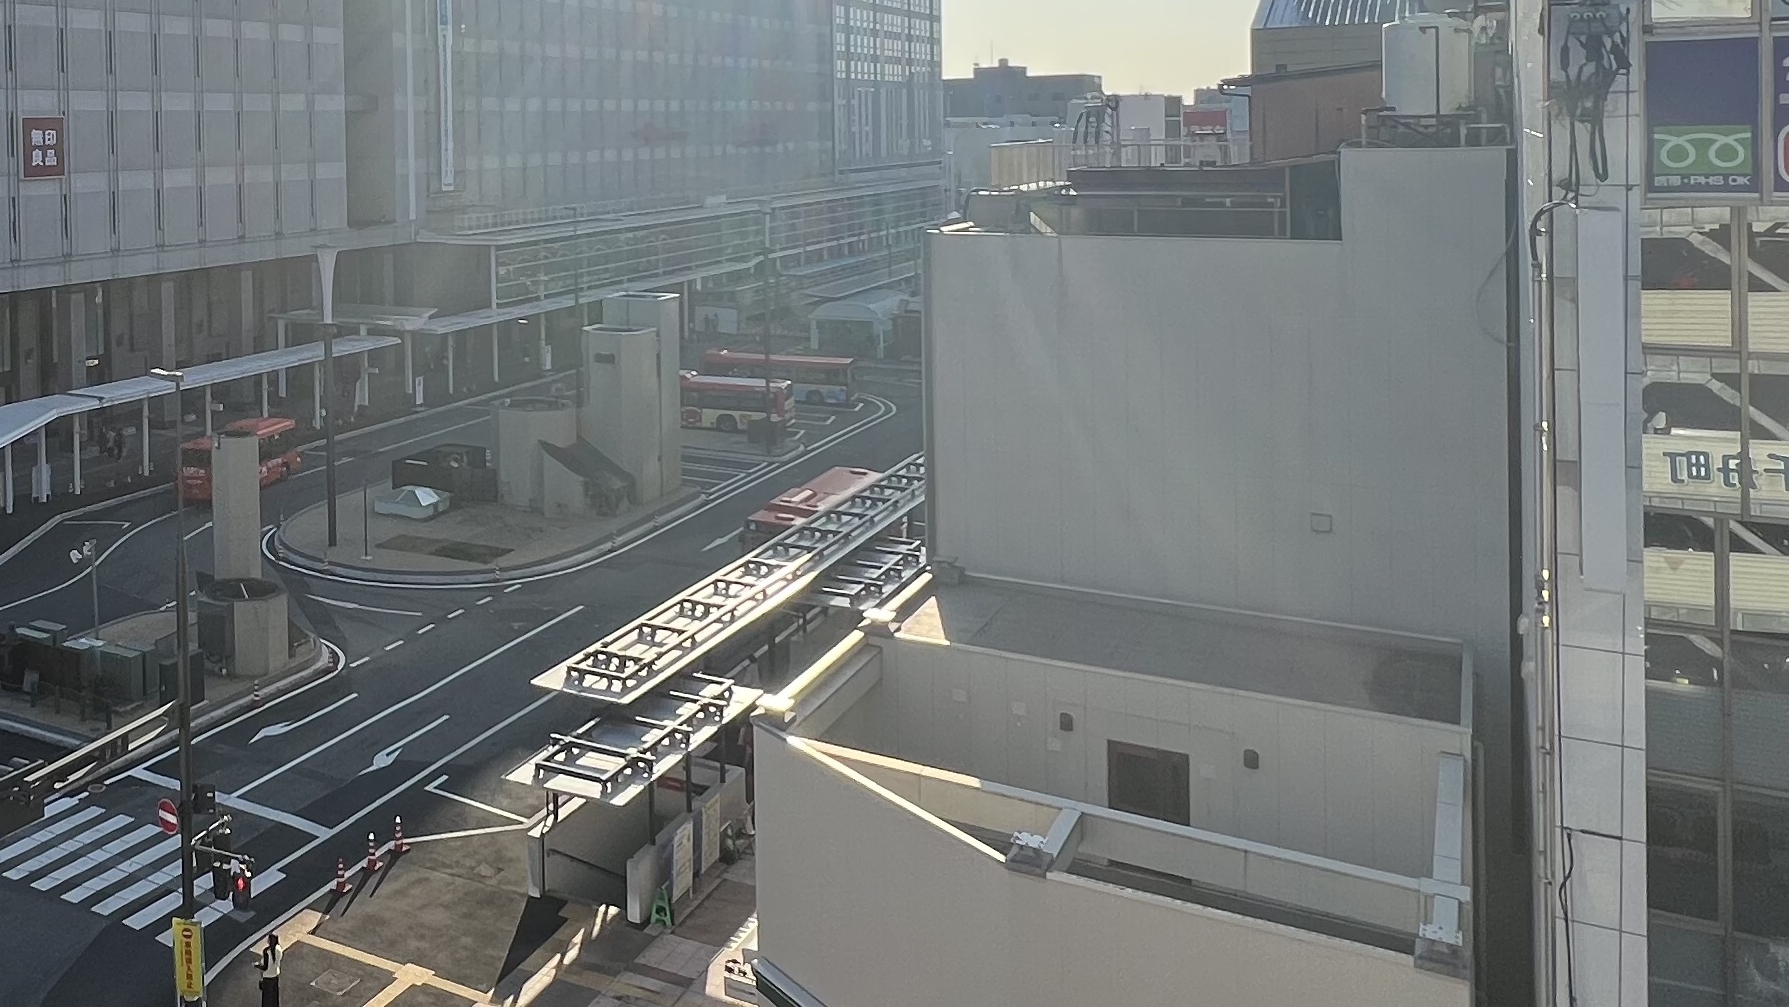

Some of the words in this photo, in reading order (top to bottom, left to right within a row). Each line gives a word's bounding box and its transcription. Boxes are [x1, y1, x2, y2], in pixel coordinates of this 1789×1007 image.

[31, 129, 57, 146] 無印
[32, 148, 58, 166] 良品
[1728, 175, 1752, 186] OK
